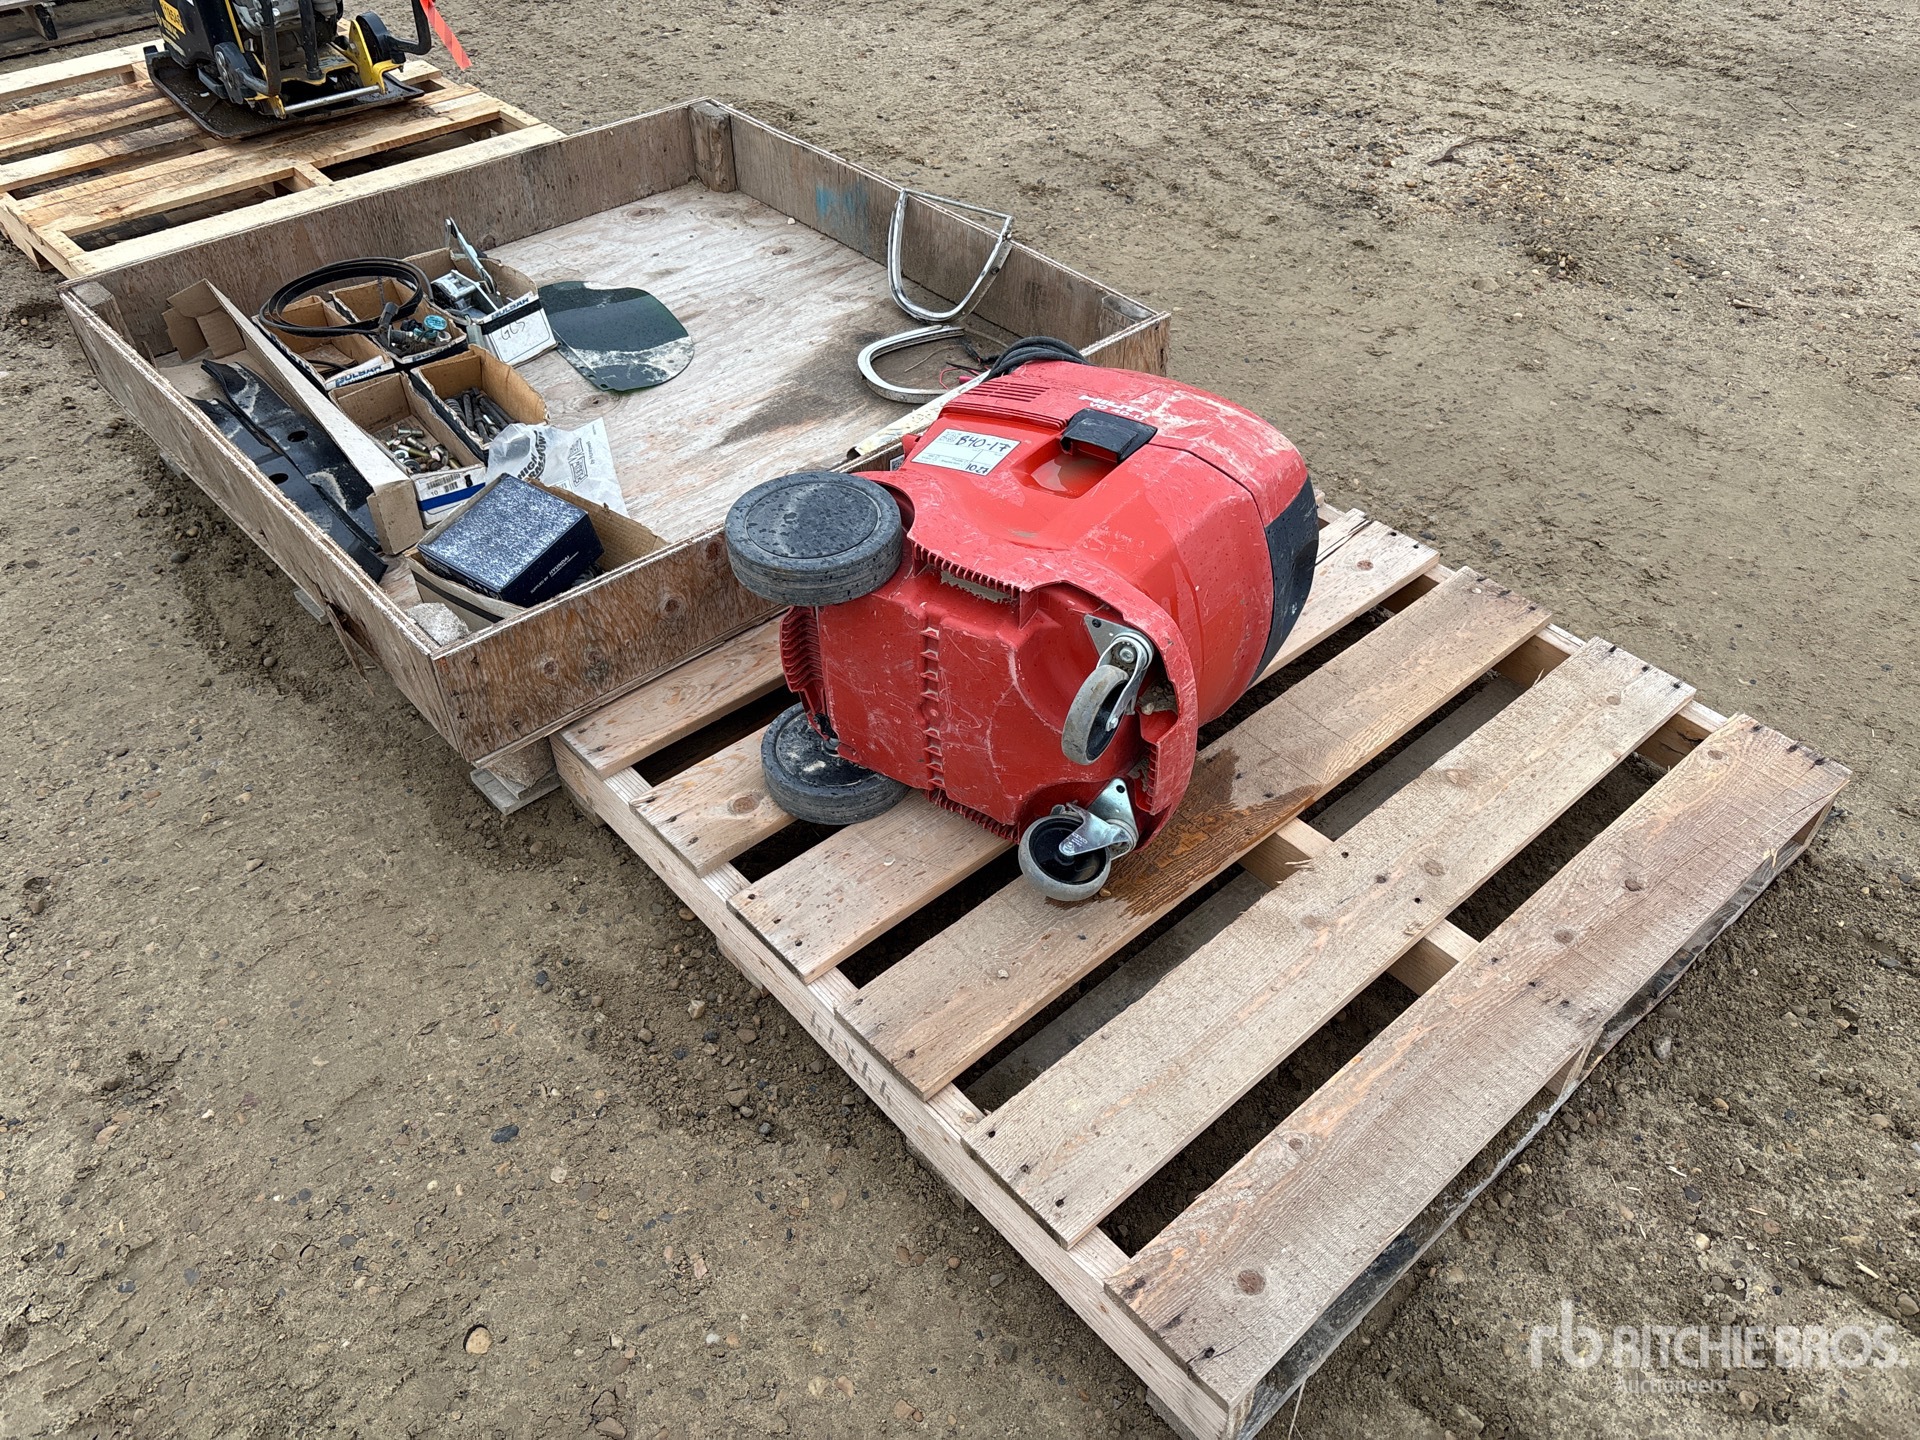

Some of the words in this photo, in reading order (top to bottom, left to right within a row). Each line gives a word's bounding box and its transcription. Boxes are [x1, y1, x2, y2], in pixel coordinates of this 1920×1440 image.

[1078, 394, 1151, 417] HILTI
[955, 434, 1011, 453] B40-17
[517, 452, 538, 480] HIGH
[431, 489, 439, 497] 10
[548, 555, 571, 576] HYUNDAI
